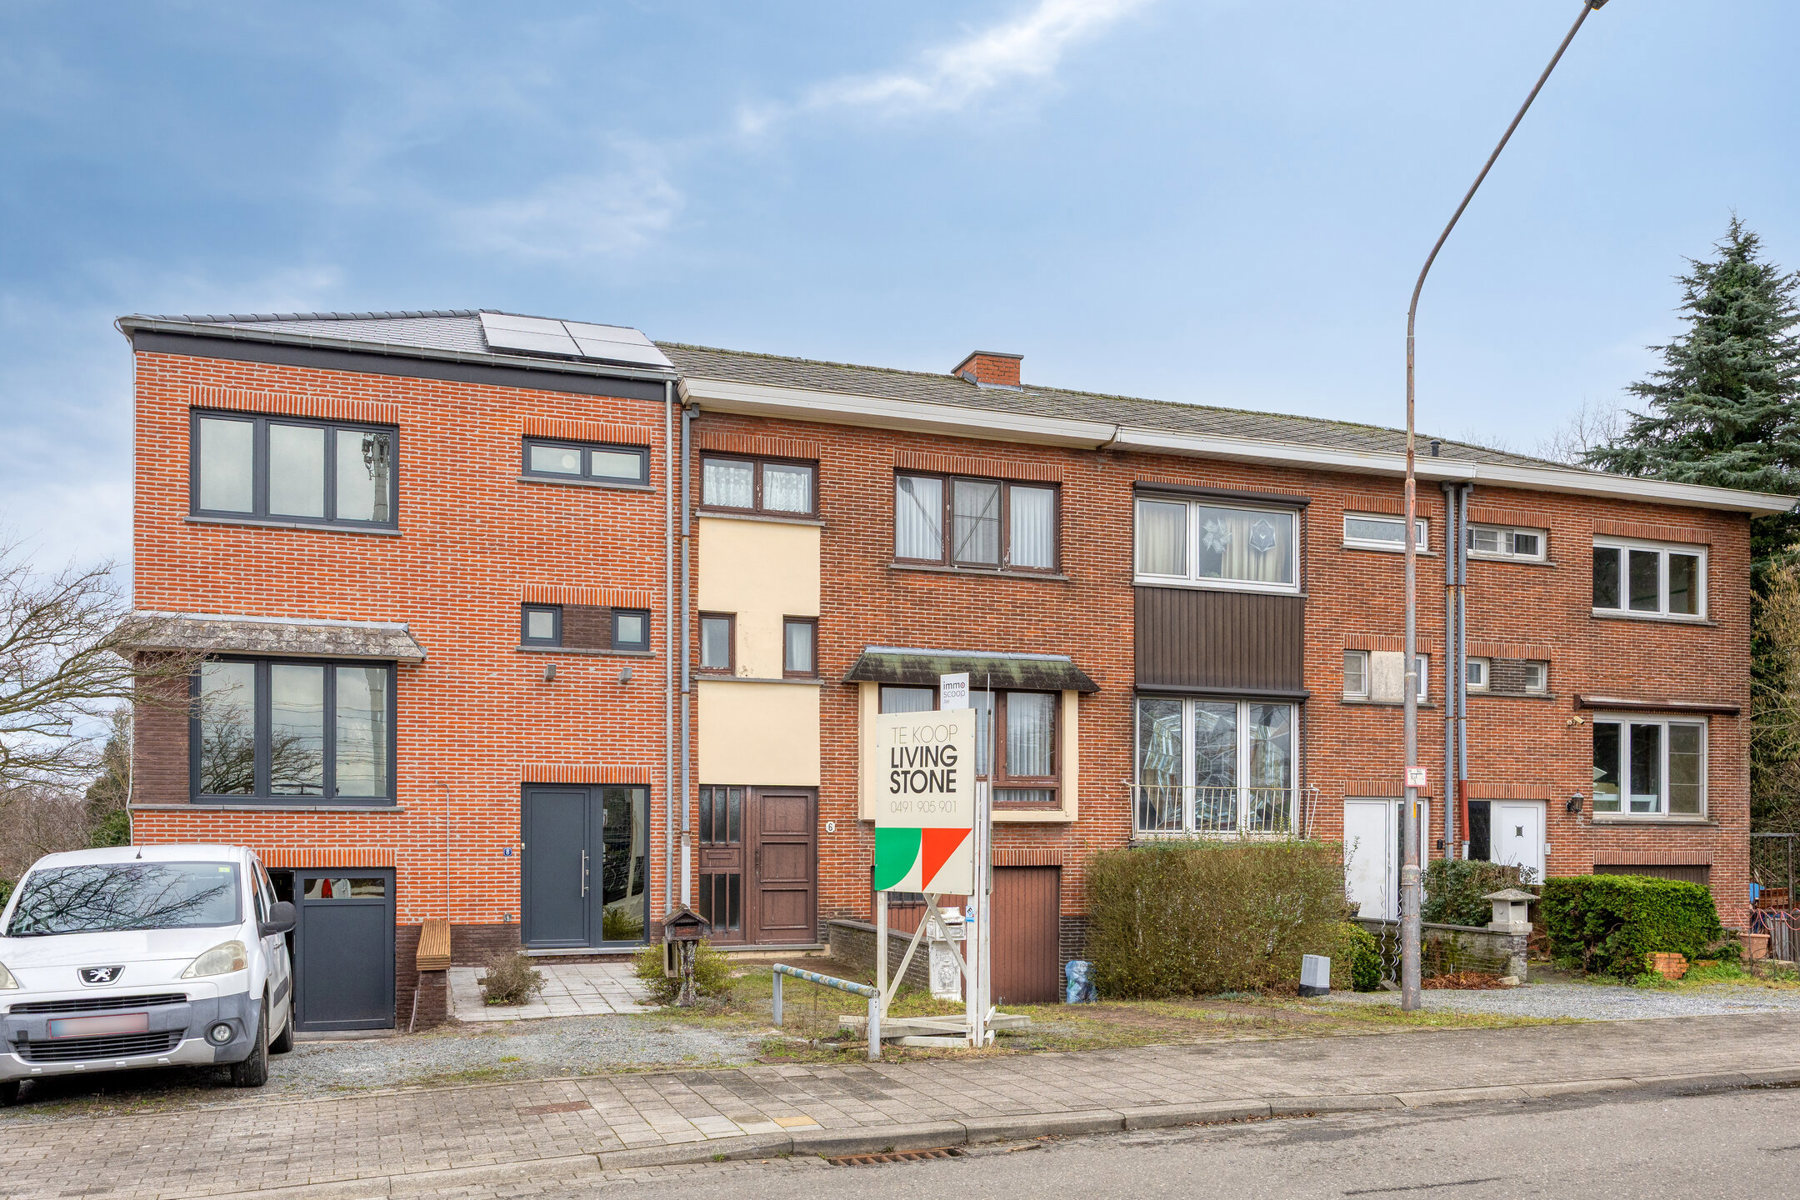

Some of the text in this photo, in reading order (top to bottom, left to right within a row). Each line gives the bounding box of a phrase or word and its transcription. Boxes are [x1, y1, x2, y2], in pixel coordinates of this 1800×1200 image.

[943, 681, 965, 690] immo
[891, 724, 958, 744] TE KOOP
[891, 744, 958, 769] LIVING
[890, 769, 957, 794] STONE
[890, 800, 957, 814] 0491 905 901
